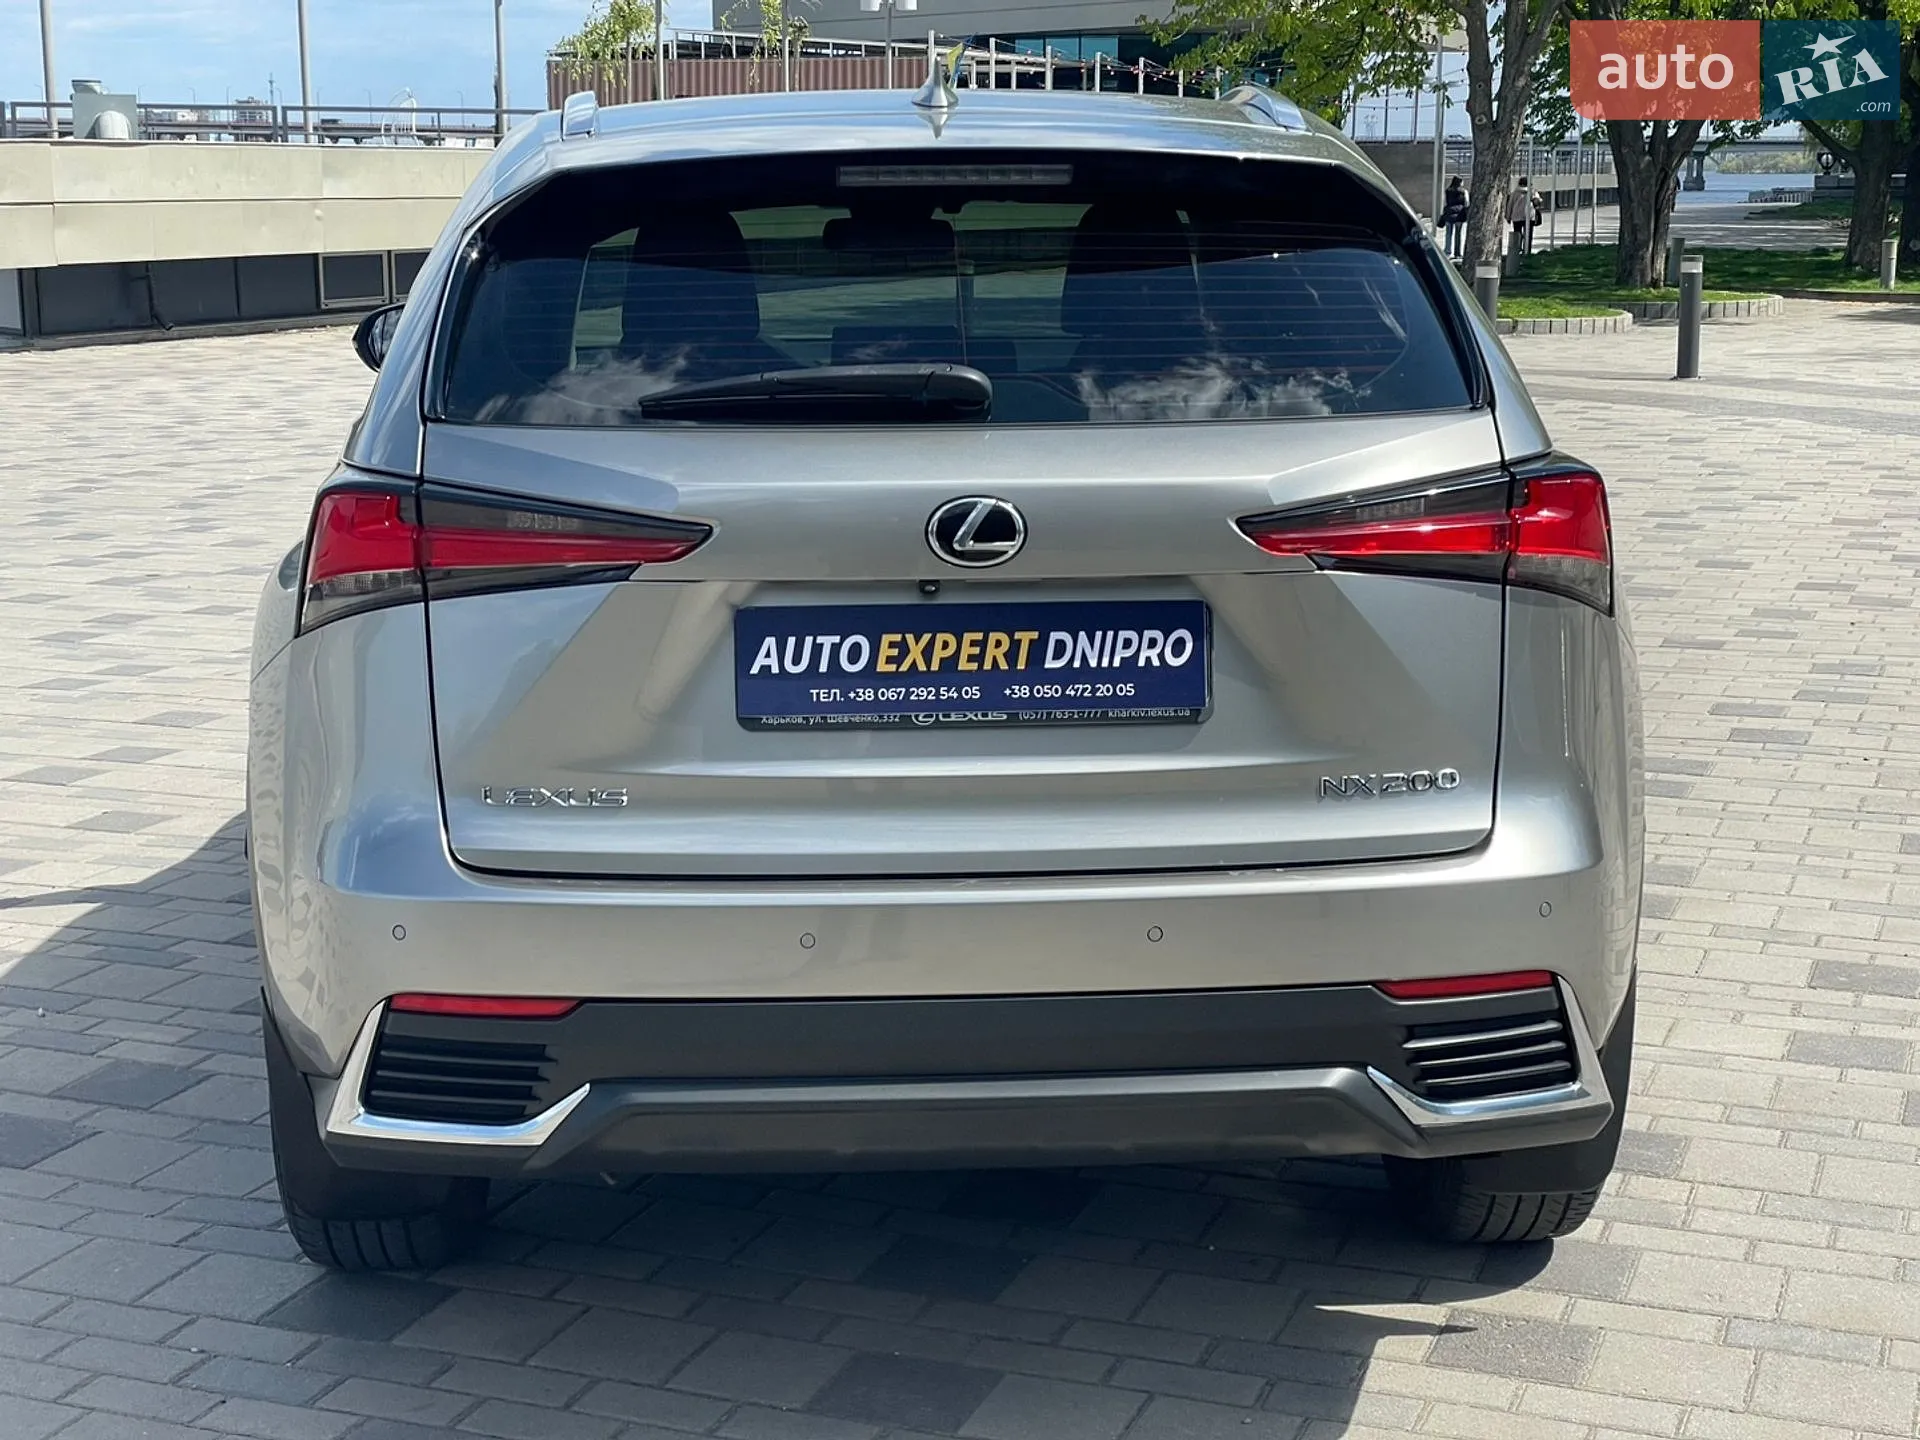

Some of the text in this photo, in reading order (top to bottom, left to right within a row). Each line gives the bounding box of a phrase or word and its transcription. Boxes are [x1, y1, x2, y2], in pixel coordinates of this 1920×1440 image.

[750, 628, 1194, 675] AUTO EXPERT DNIPRO
[810, 686, 981, 702] ТЕЛ. +38 067 292 54 05
[1003, 683, 1135, 698] +38 050 472 20 05
[481, 786, 629, 808] LEXUS
